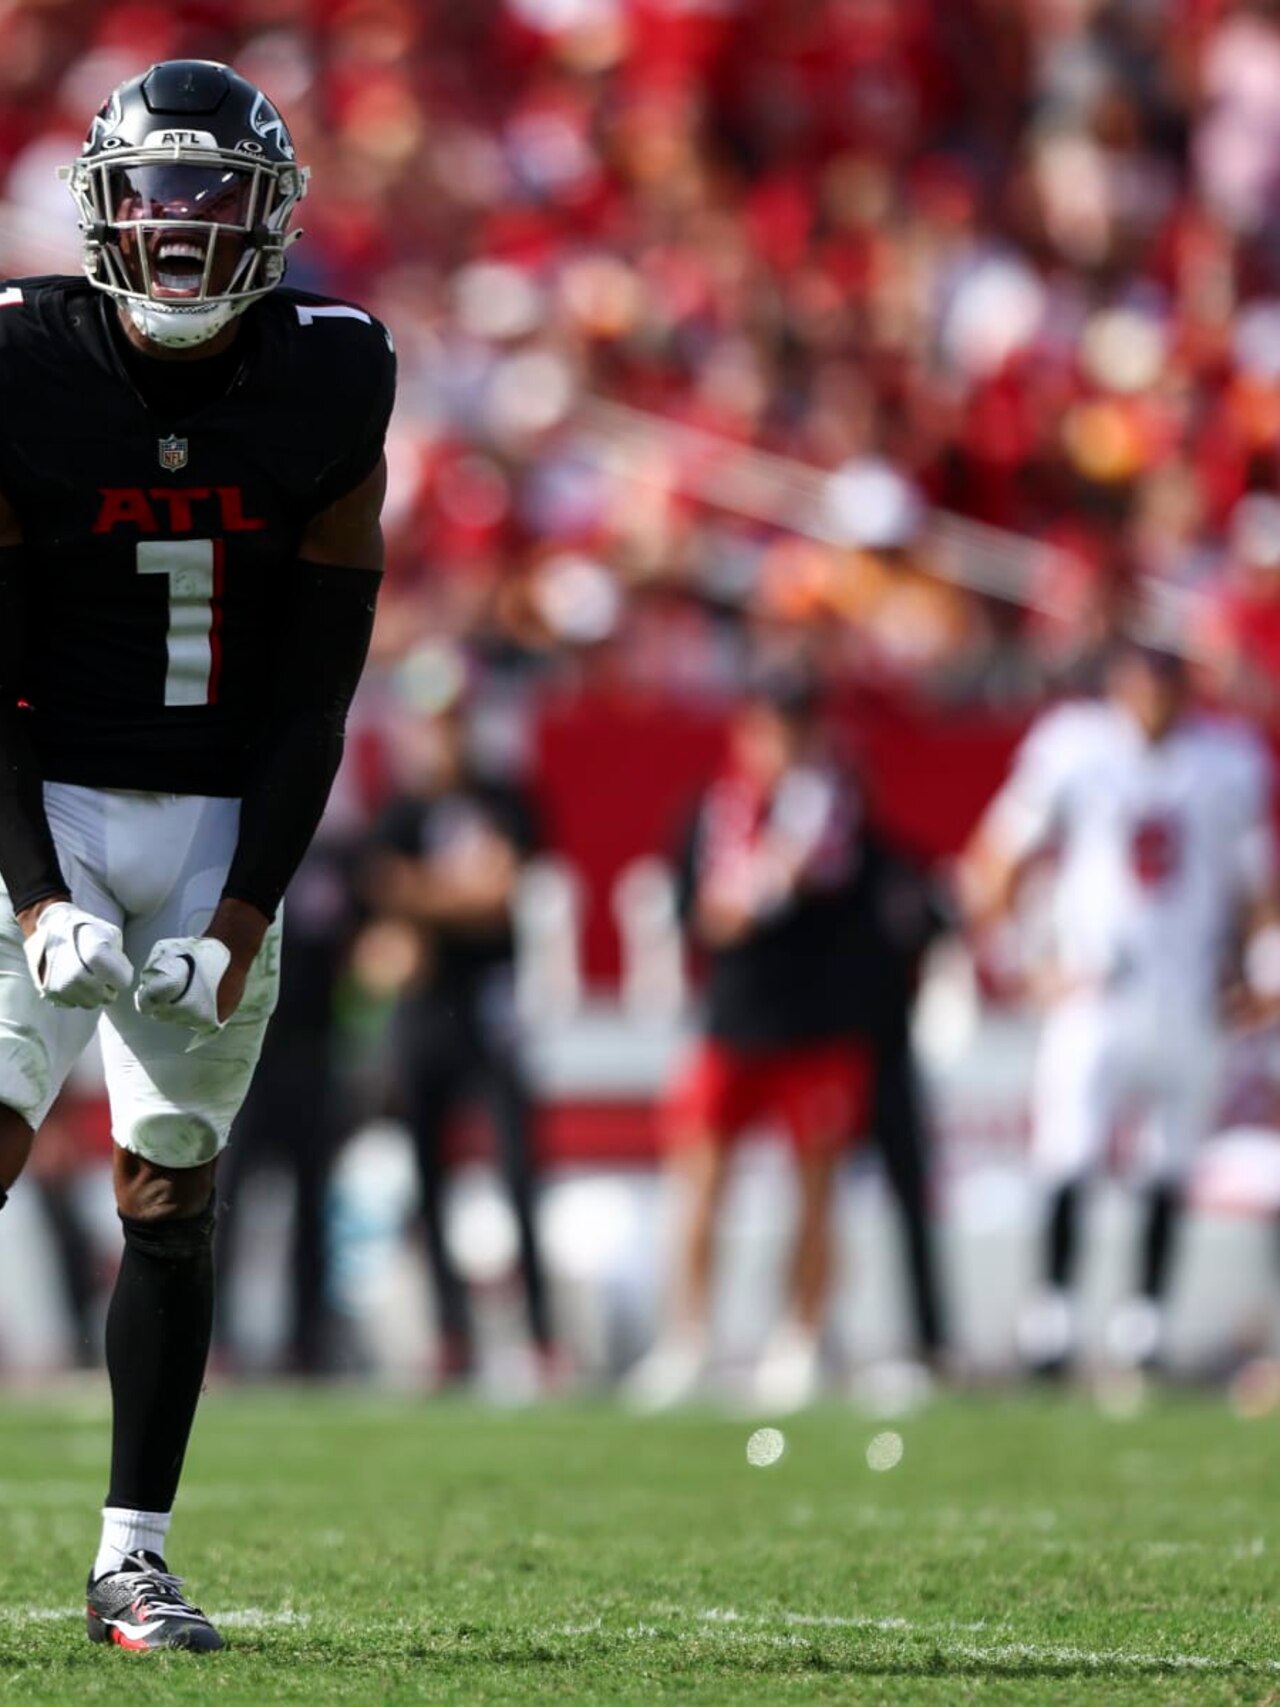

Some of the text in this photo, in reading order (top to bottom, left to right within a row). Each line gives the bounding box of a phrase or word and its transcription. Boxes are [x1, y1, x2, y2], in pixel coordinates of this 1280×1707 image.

[162, 132, 200, 144] ATL
[164, 452, 185, 464] NFL
[92, 486, 267, 534] ATL
[136, 537, 224, 706] 1
